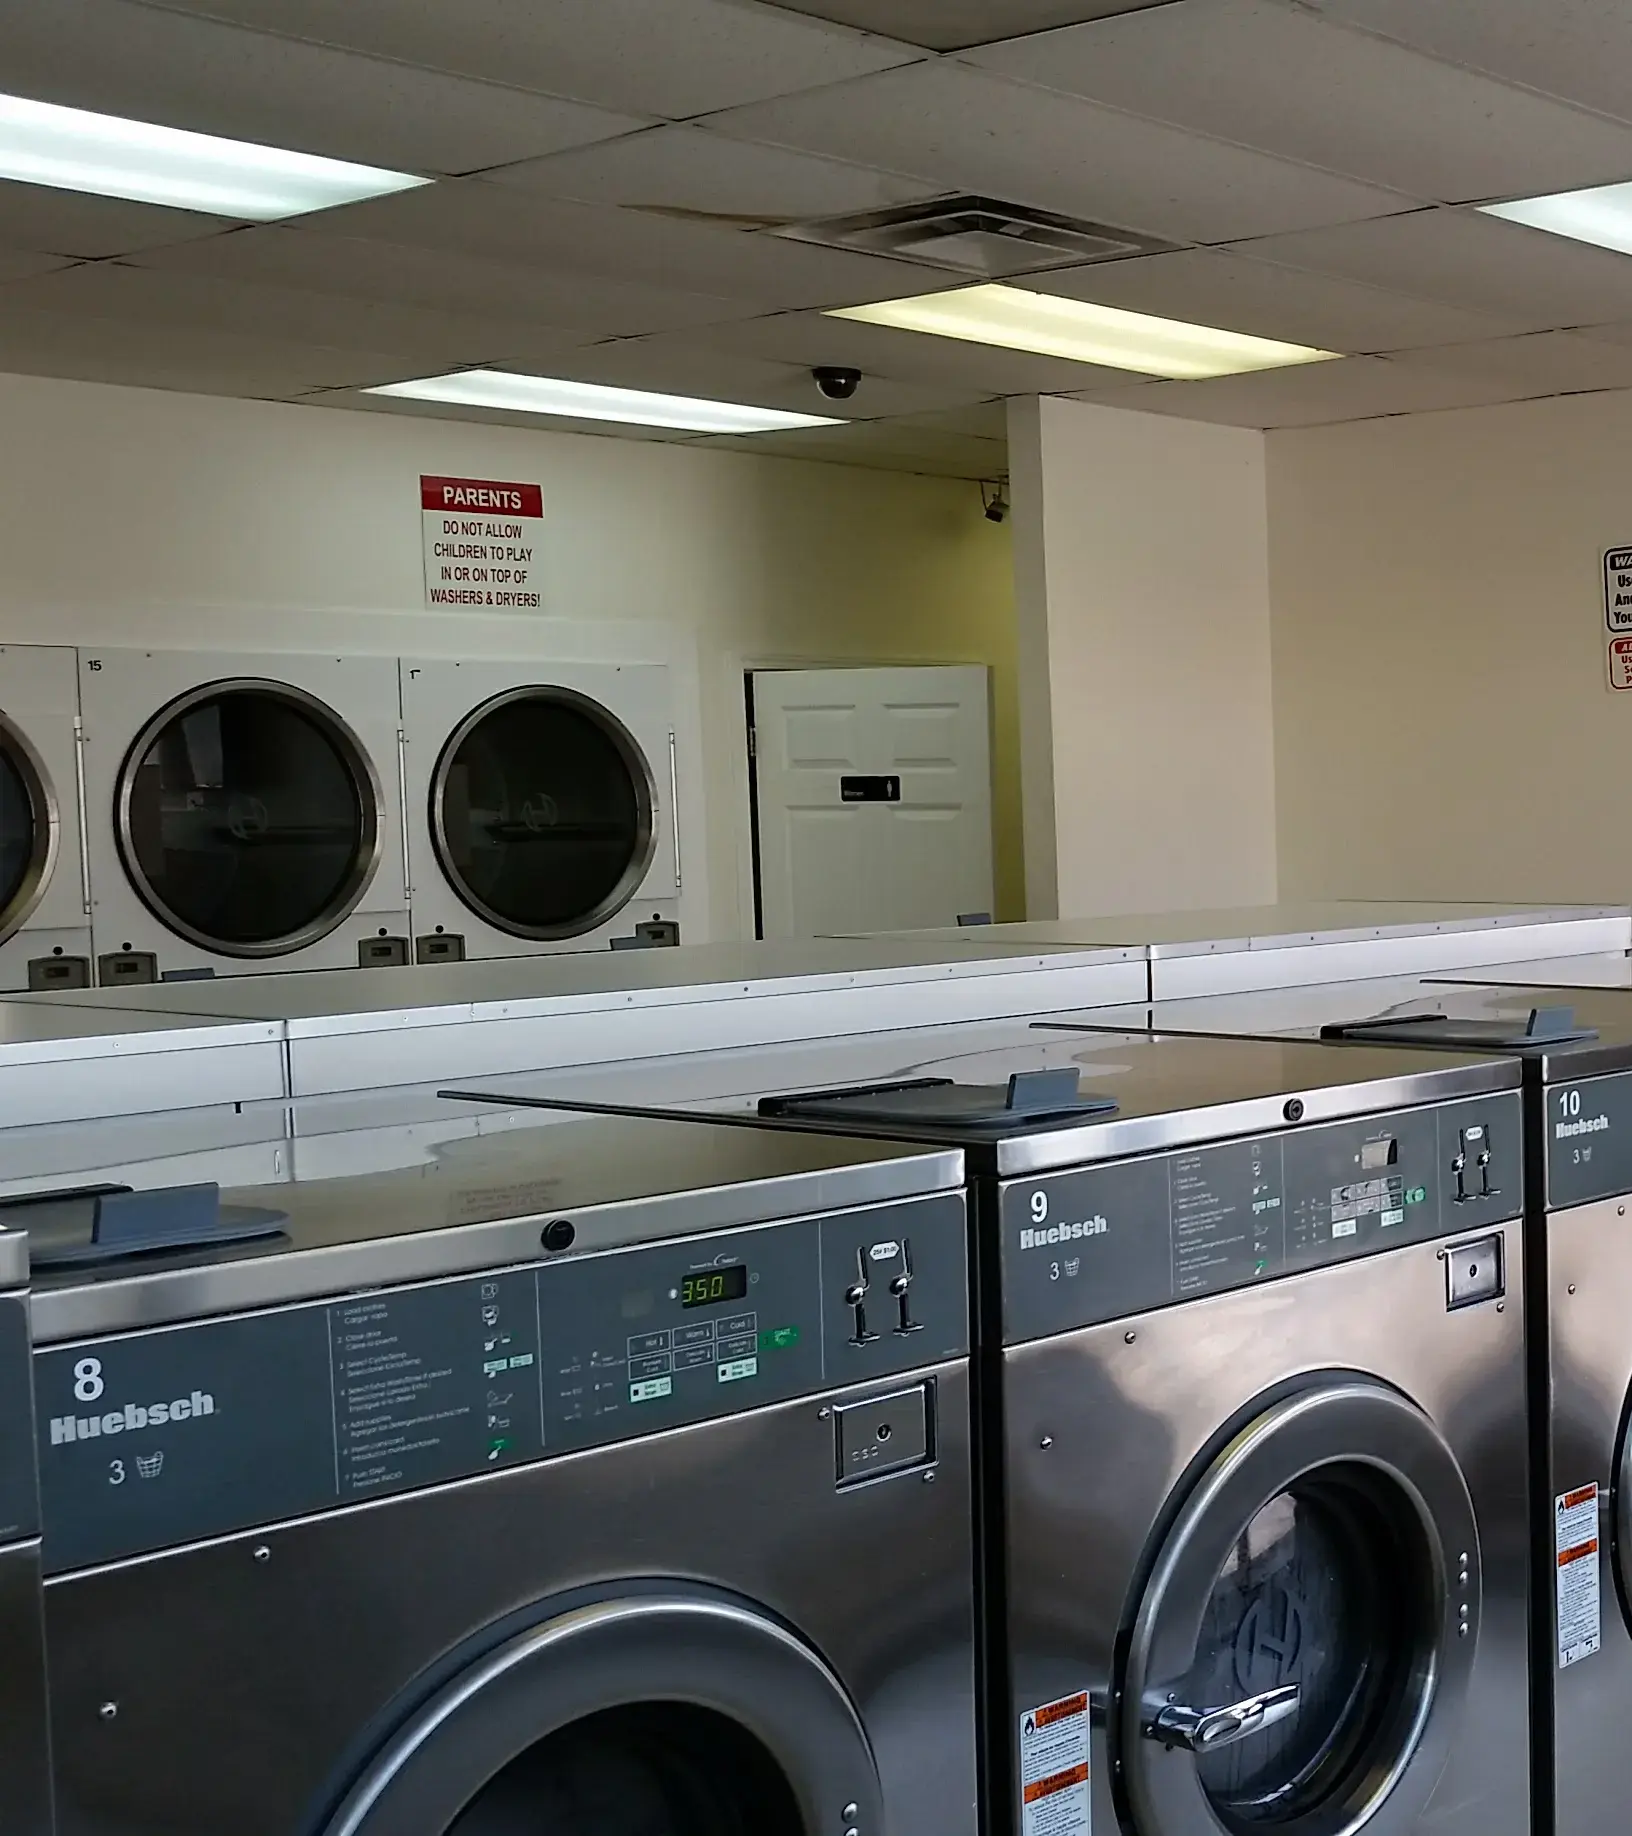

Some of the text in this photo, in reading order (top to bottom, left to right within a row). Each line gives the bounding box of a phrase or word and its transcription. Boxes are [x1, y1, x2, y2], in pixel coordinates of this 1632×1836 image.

[443, 486, 521, 509] PARENTS
[444, 521, 522, 538] DO NOT ALLOW
[434, 543, 532, 561] CHILDREN TO PLAY
[442, 566, 527, 583] IN OR ON TOP OF
[431, 589, 540, 606] WASHERS & DRYERS!
[87, 660, 101, 671] 15
[1559, 1090, 1580, 1116] 10
[1556, 1115, 1608, 1139] Huebsch
[1573, 1149, 1580, 1164] 3
[1031, 1191, 1048, 1222] 9
[1020, 1215, 1107, 1250] Huebsch
[1050, 1262, 1059, 1280] 3
[682, 1276, 723, 1303] 350
[74, 1357, 105, 1401] 8
[50, 1390, 215, 1445] Huebsch
[109, 1460, 126, 1484] 3
